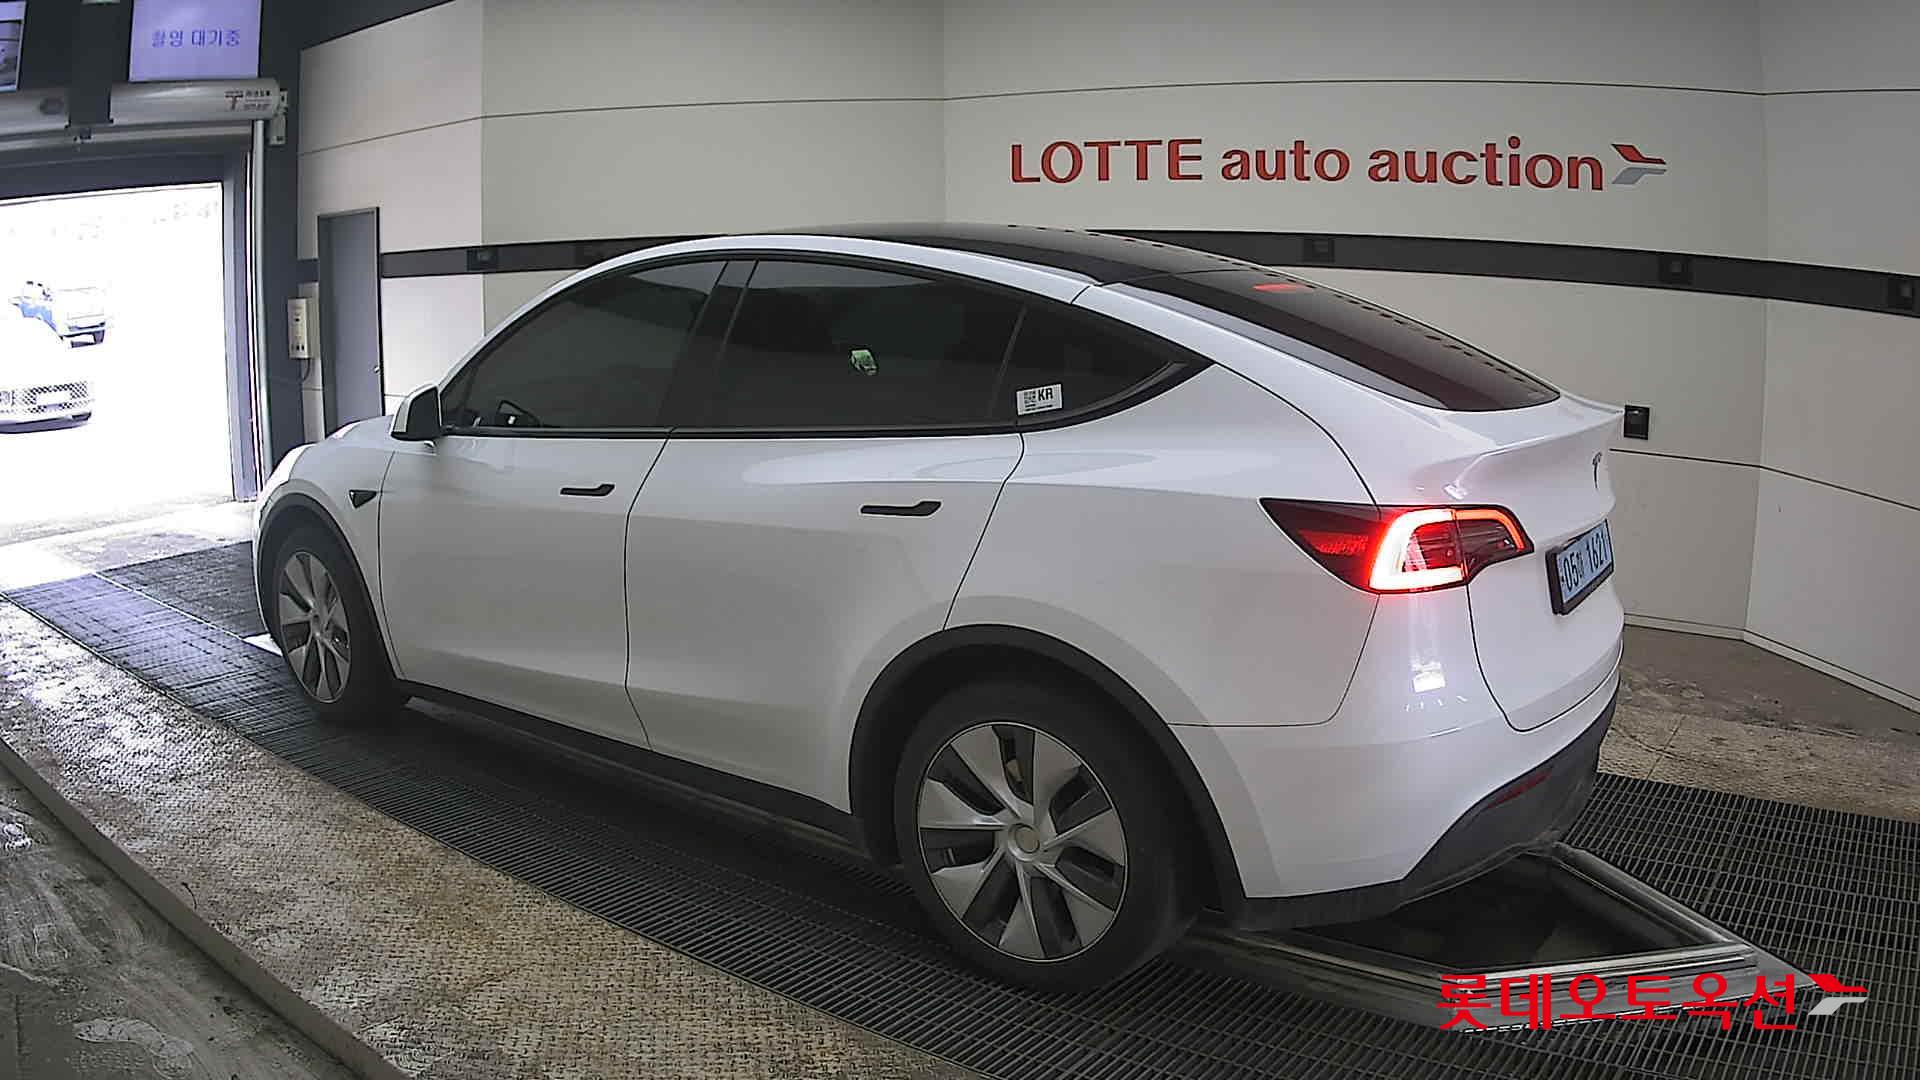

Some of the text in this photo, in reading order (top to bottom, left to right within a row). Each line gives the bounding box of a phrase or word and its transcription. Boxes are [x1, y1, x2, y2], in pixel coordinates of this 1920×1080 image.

[192, 29, 240, 48] 대기중
[1011, 136, 1604, 190] LOTTE auto auction
[1038, 387, 1053, 401] KR
[1586, 531, 1608, 573] 1621
